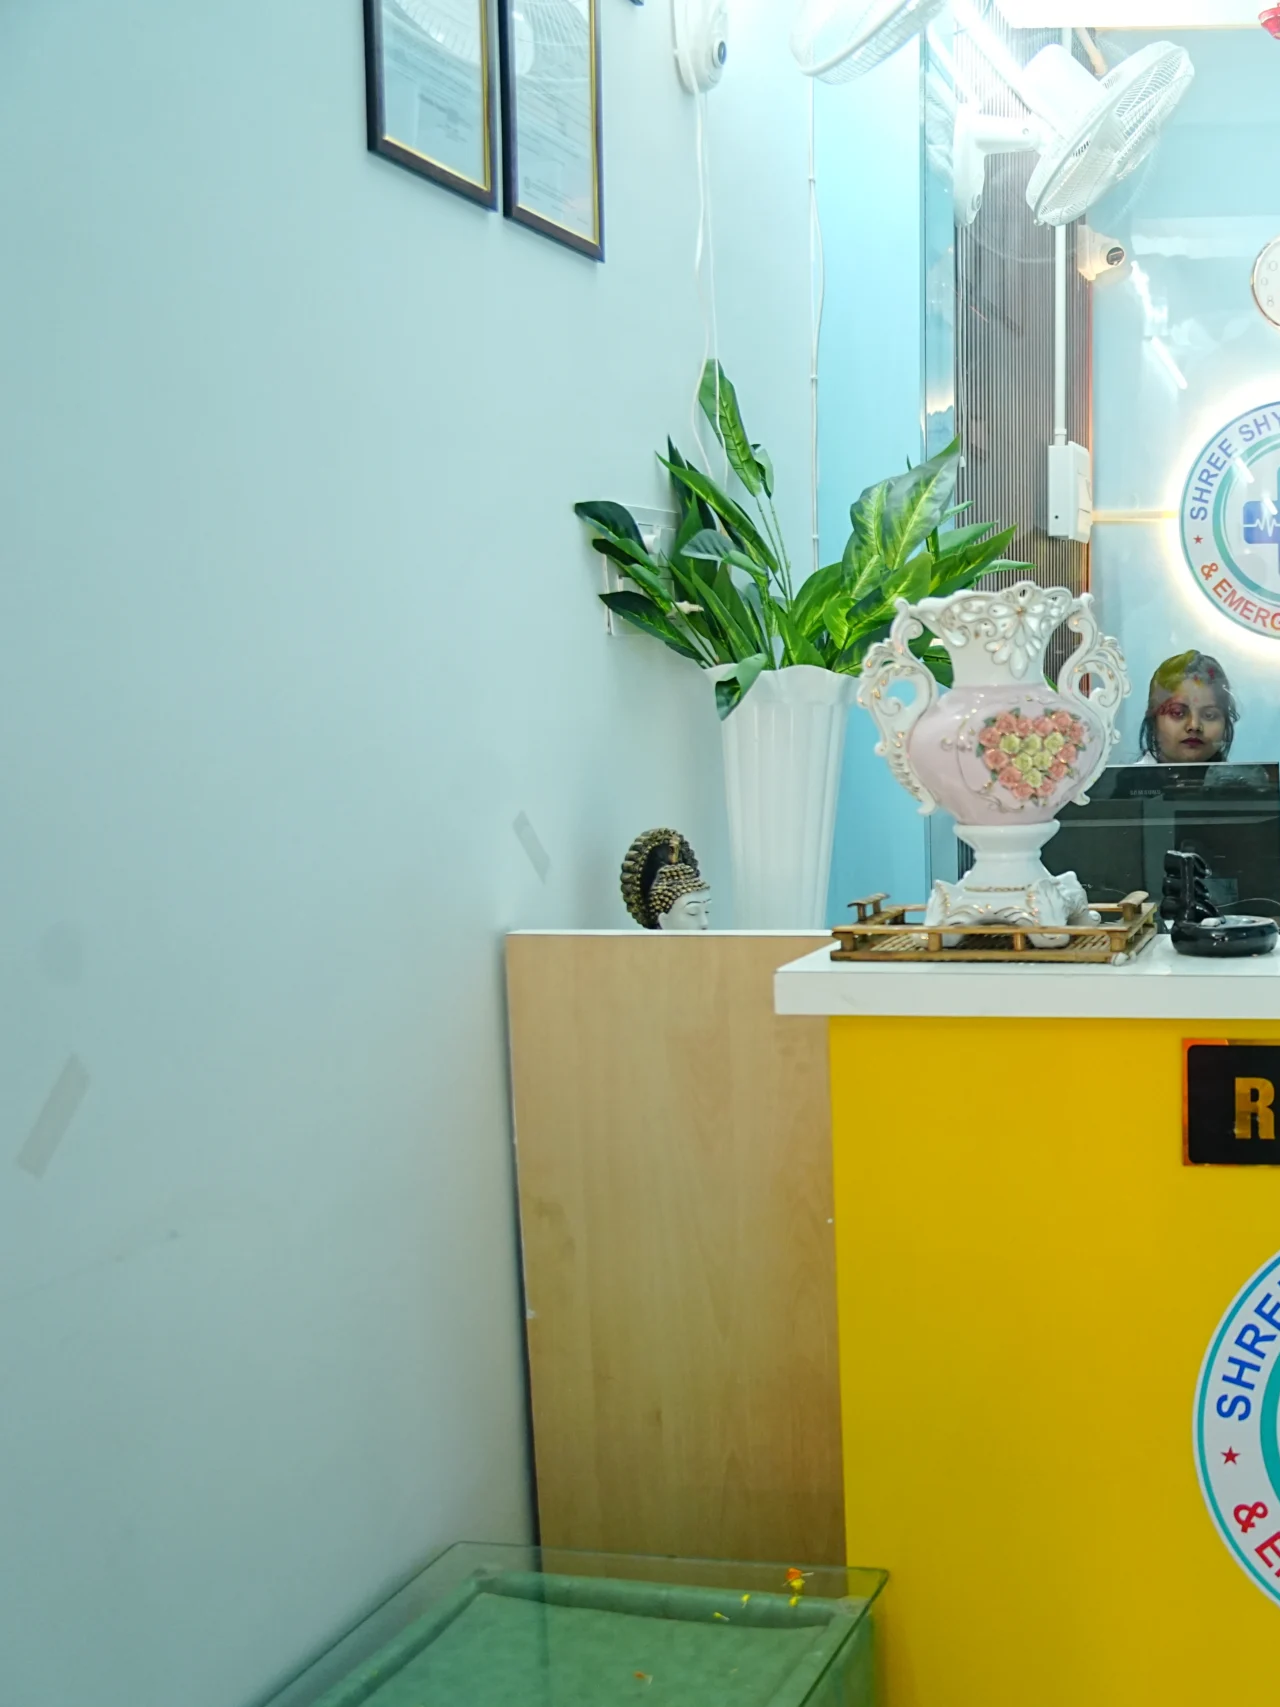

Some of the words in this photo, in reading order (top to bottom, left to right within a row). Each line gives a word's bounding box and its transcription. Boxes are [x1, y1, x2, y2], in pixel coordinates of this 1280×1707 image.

[1190, 438, 1238, 521] SHREE
[1201, 562, 1219, 581] &
[1232, 1500, 1270, 1535] &
